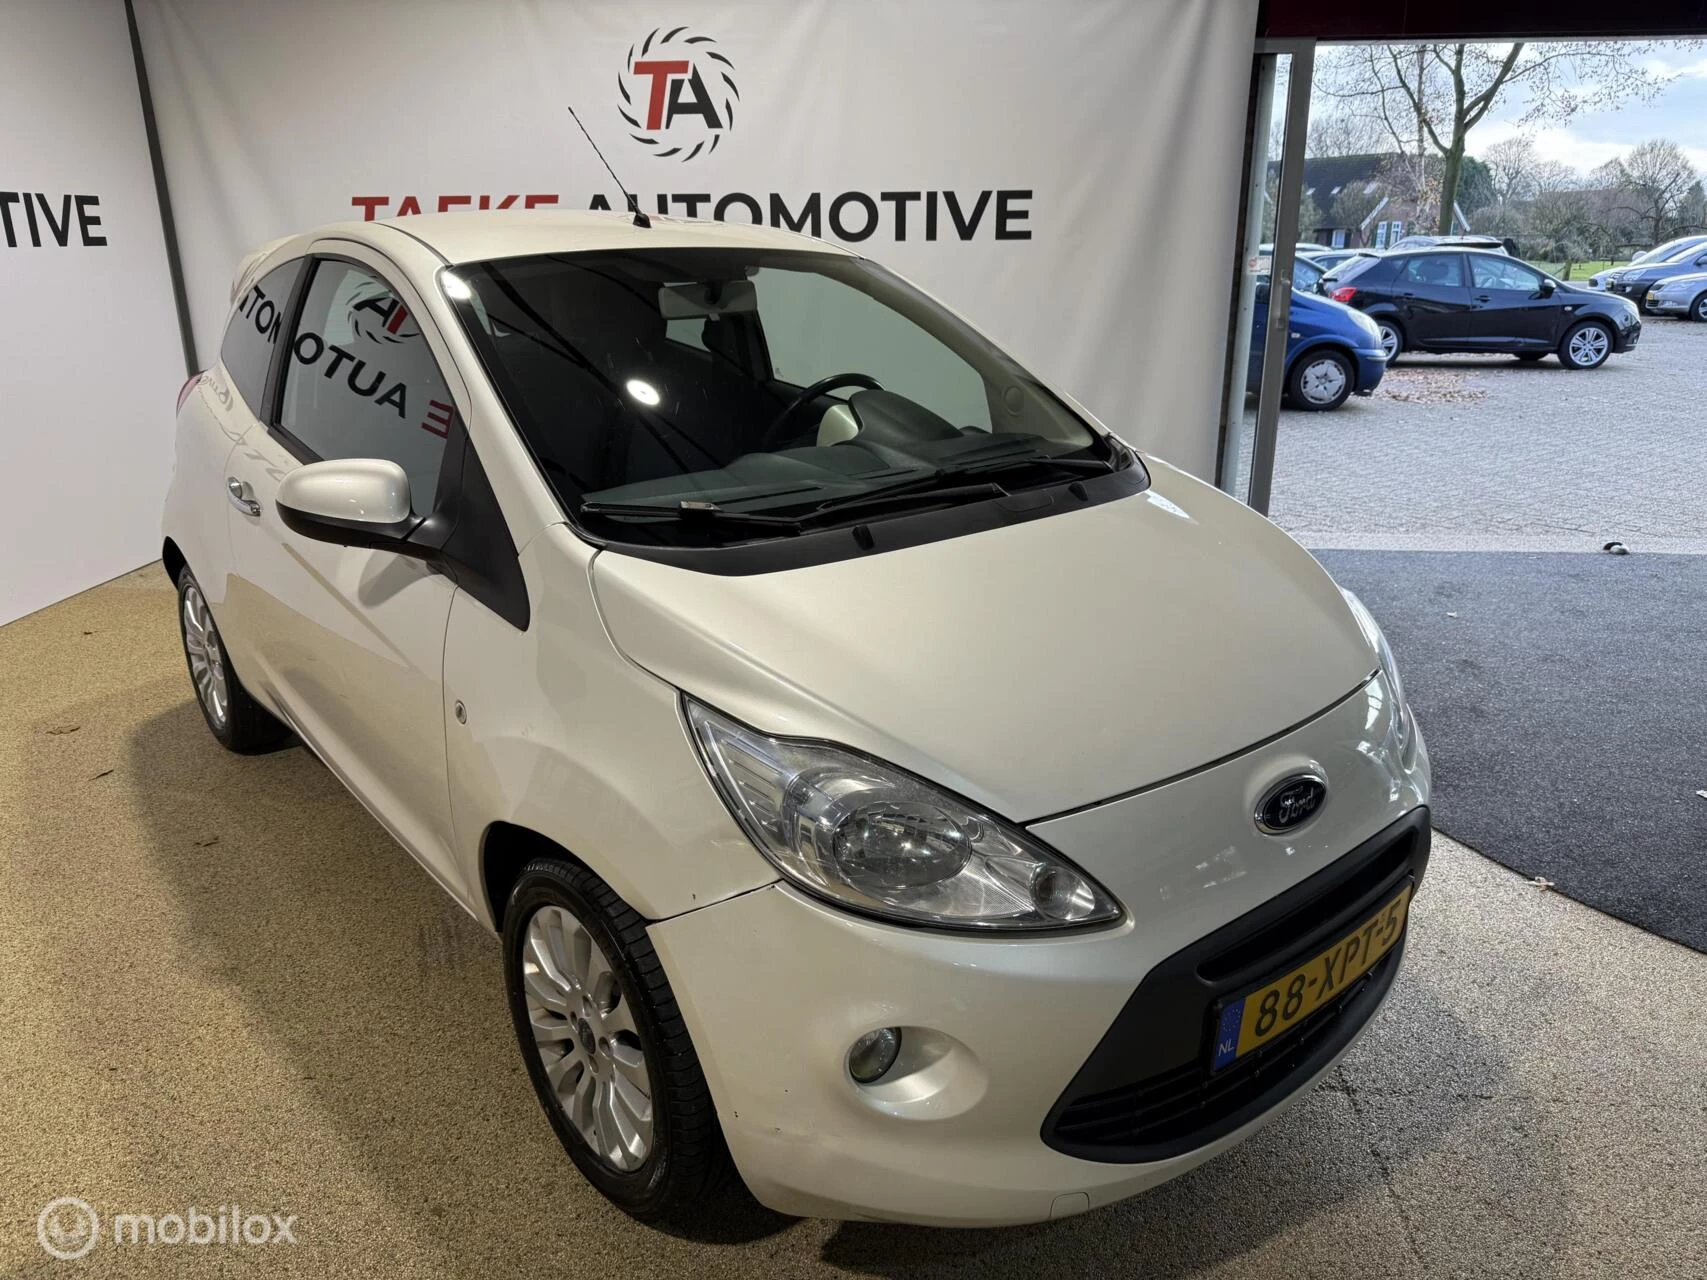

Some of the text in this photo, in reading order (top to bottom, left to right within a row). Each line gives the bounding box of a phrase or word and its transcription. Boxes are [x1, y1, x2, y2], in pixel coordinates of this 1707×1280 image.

[633, 60, 723, 131] TA
[1278, 785, 1315, 824] Ford
[1218, 900, 1401, 1057] NL 88-XPT-5
